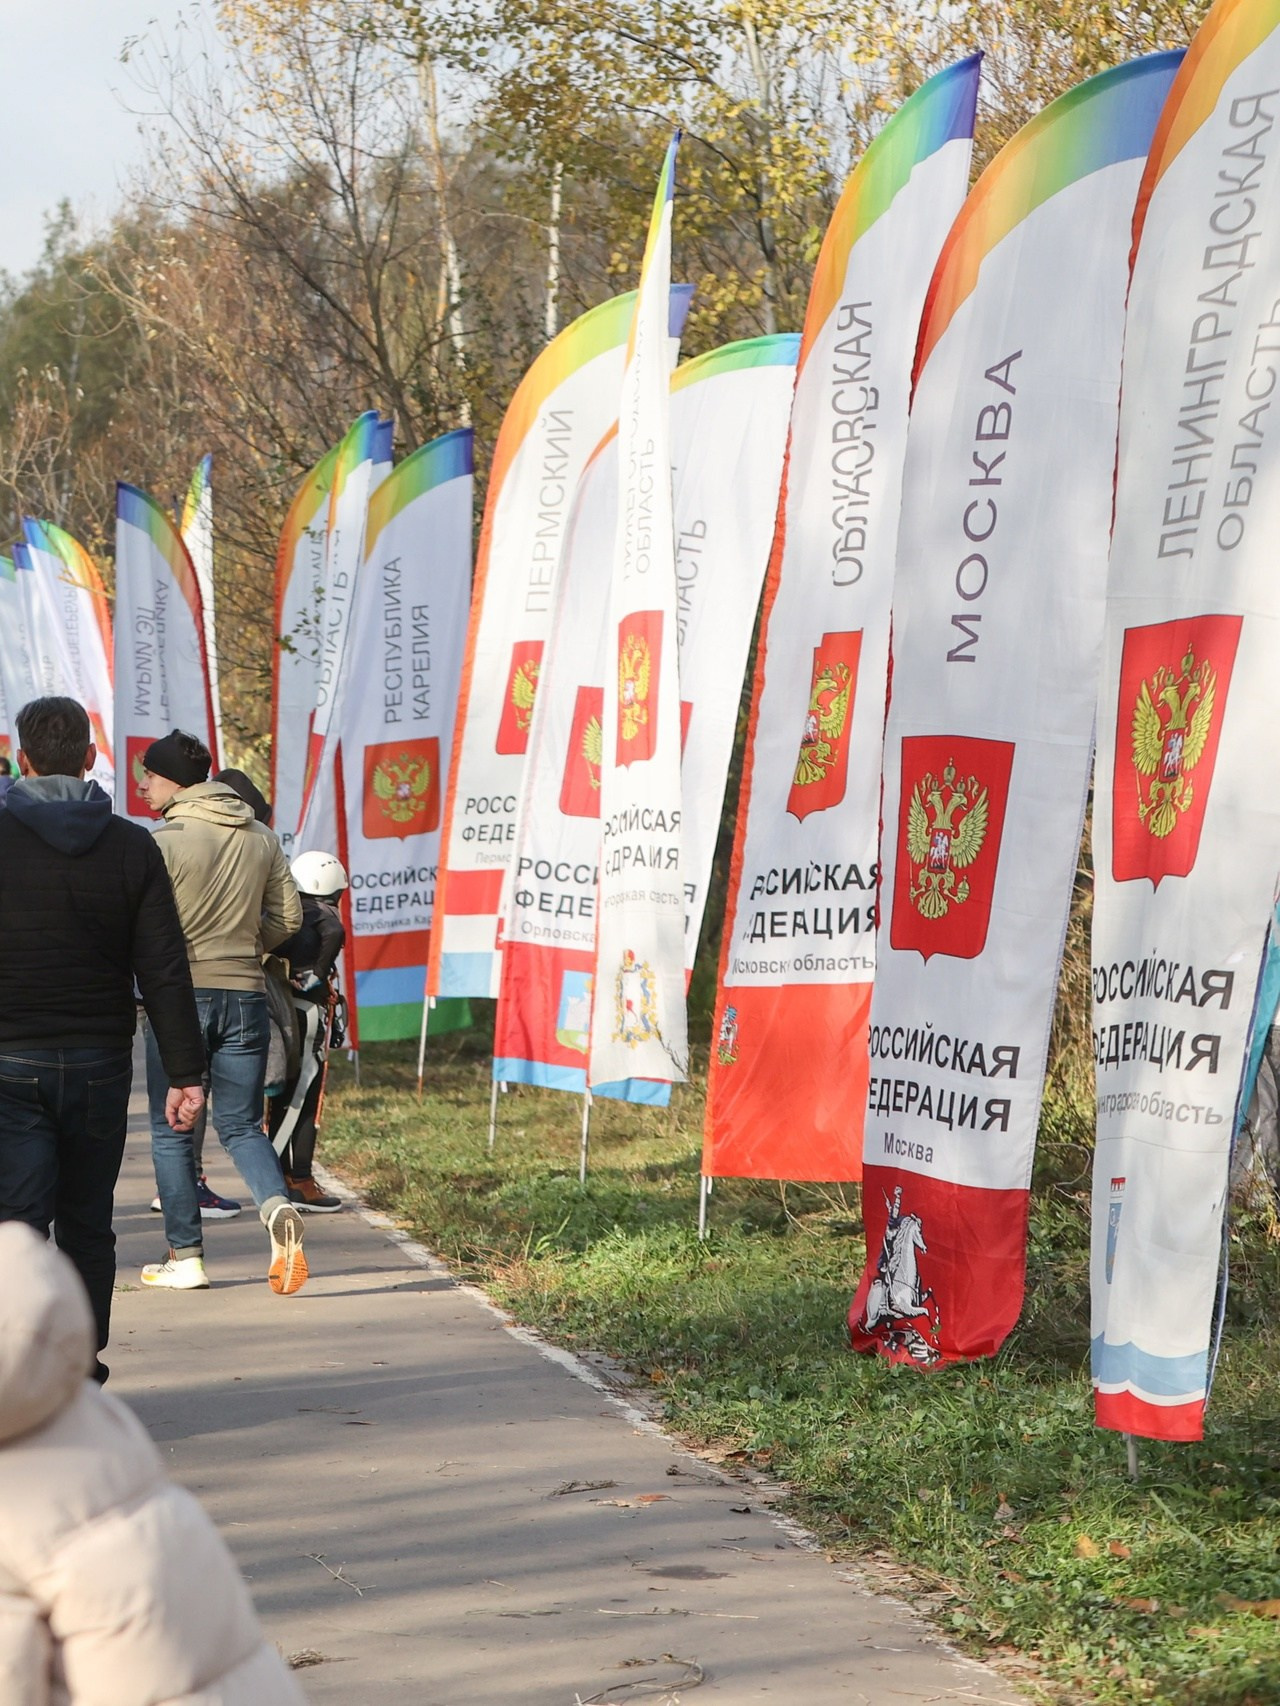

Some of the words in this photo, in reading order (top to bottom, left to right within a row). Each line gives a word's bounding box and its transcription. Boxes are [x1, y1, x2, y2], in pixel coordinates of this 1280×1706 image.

[1157, 88, 1280, 560] ЛЕНИНГРАДСКАЯ
[525, 409, 574, 614] ПЕРМСКИЙ
[636, 437, 655, 575] ОБЛАСТЬ
[947, 349, 1023, 664] МОСКВА
[382, 556, 403, 725] РЕСПУБЛИКА
[411, 604, 431, 721] КАРЕЛИЯ
[793, 953, 875, 973] область
[884, 1131, 934, 1164] Москва
[1140, 1090, 1223, 1126] область
